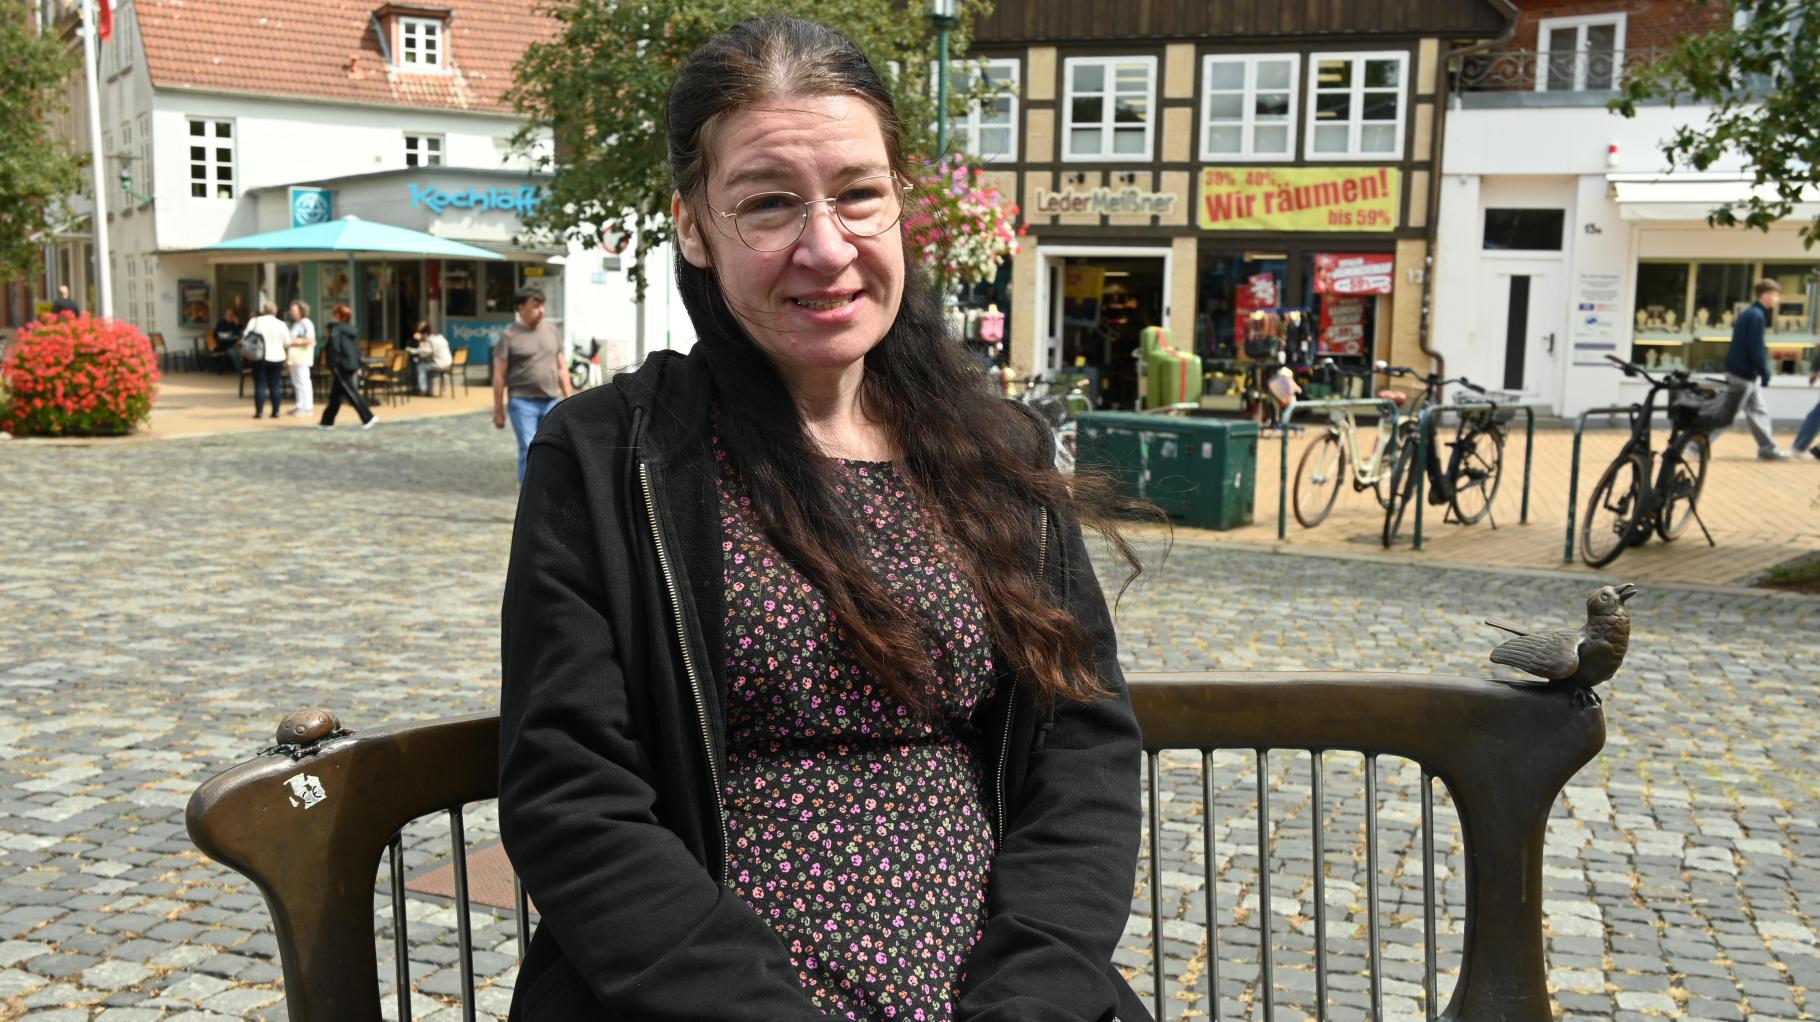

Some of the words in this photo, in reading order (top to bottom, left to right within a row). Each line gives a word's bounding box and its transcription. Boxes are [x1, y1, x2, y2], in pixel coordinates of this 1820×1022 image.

[407, 182, 556, 217] Kochlöff
[1205, 190, 1256, 223] Wir
[1263, 168, 1389, 215] räumen!
[1328, 209, 1352, 225] bis
[1356, 209, 1391, 225] 59%
